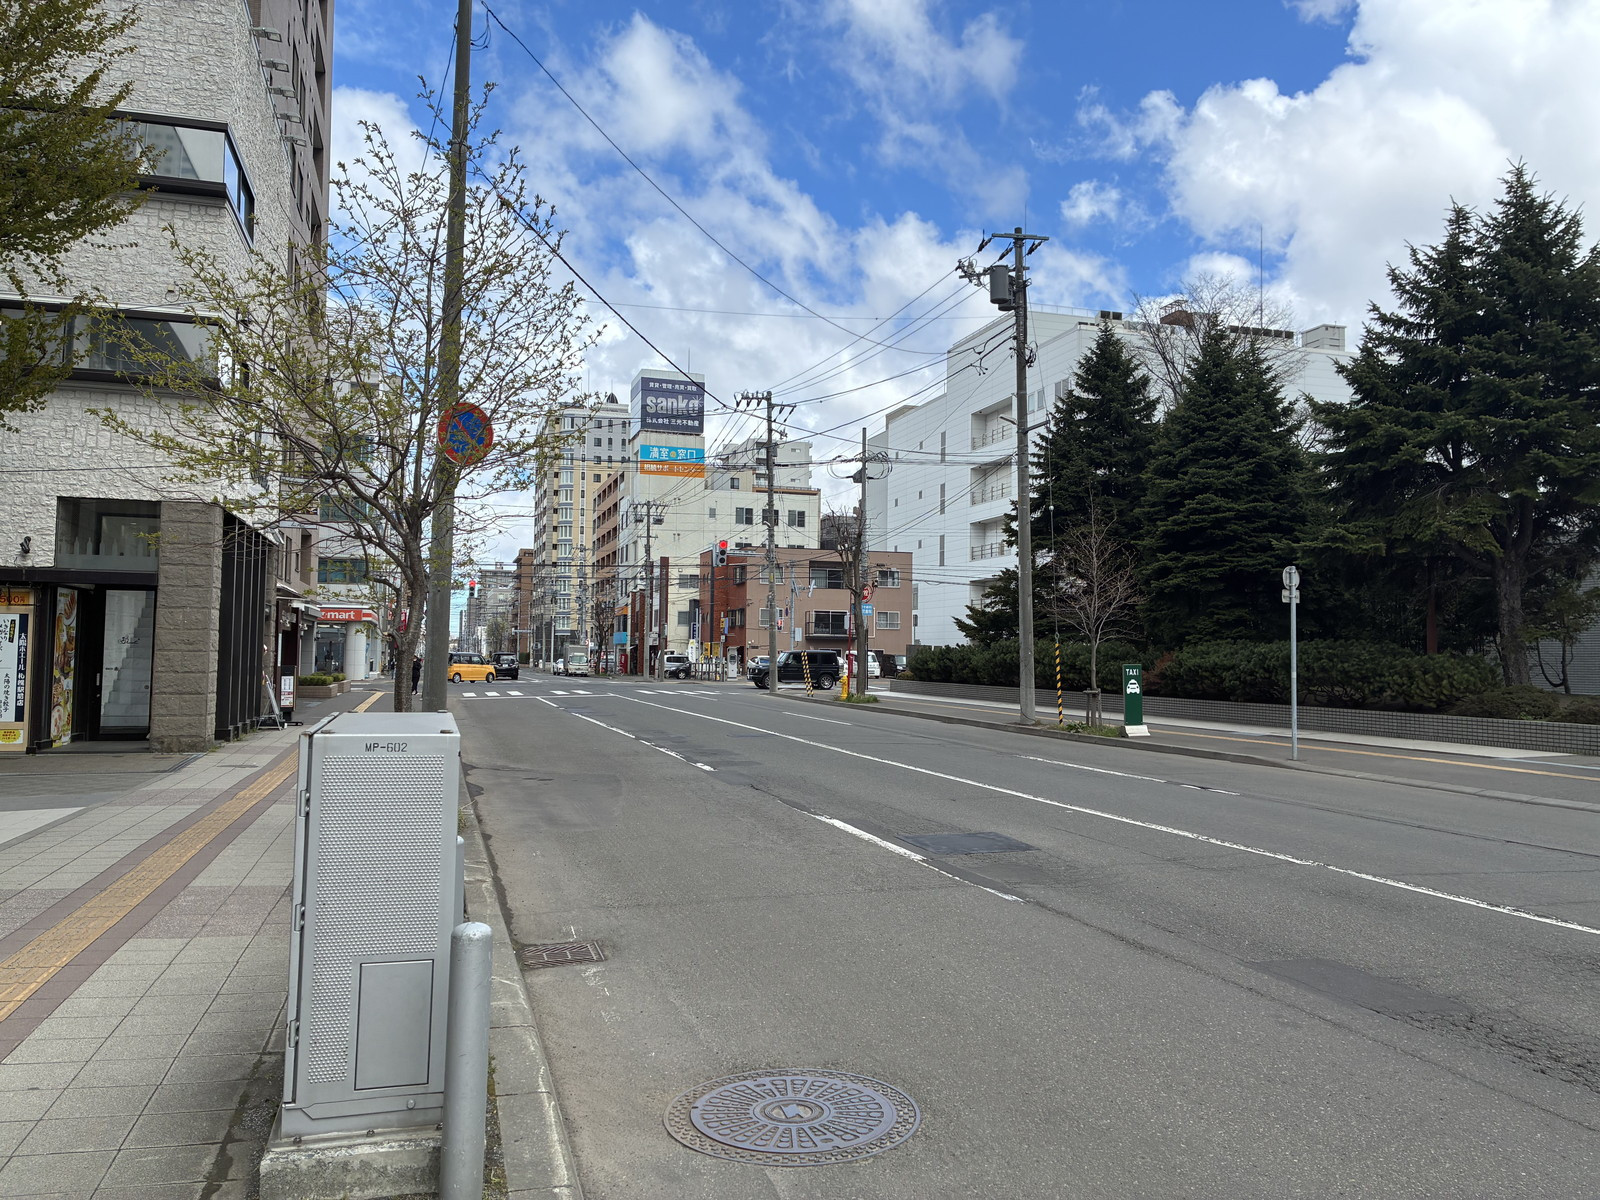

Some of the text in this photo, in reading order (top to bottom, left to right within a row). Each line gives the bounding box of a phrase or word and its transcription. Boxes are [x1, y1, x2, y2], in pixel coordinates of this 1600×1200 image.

[646, 394, 699, 416] sanko
[1126, 668, 1139, 676] TAXI
[365, 742, 408, 753] MP-602
